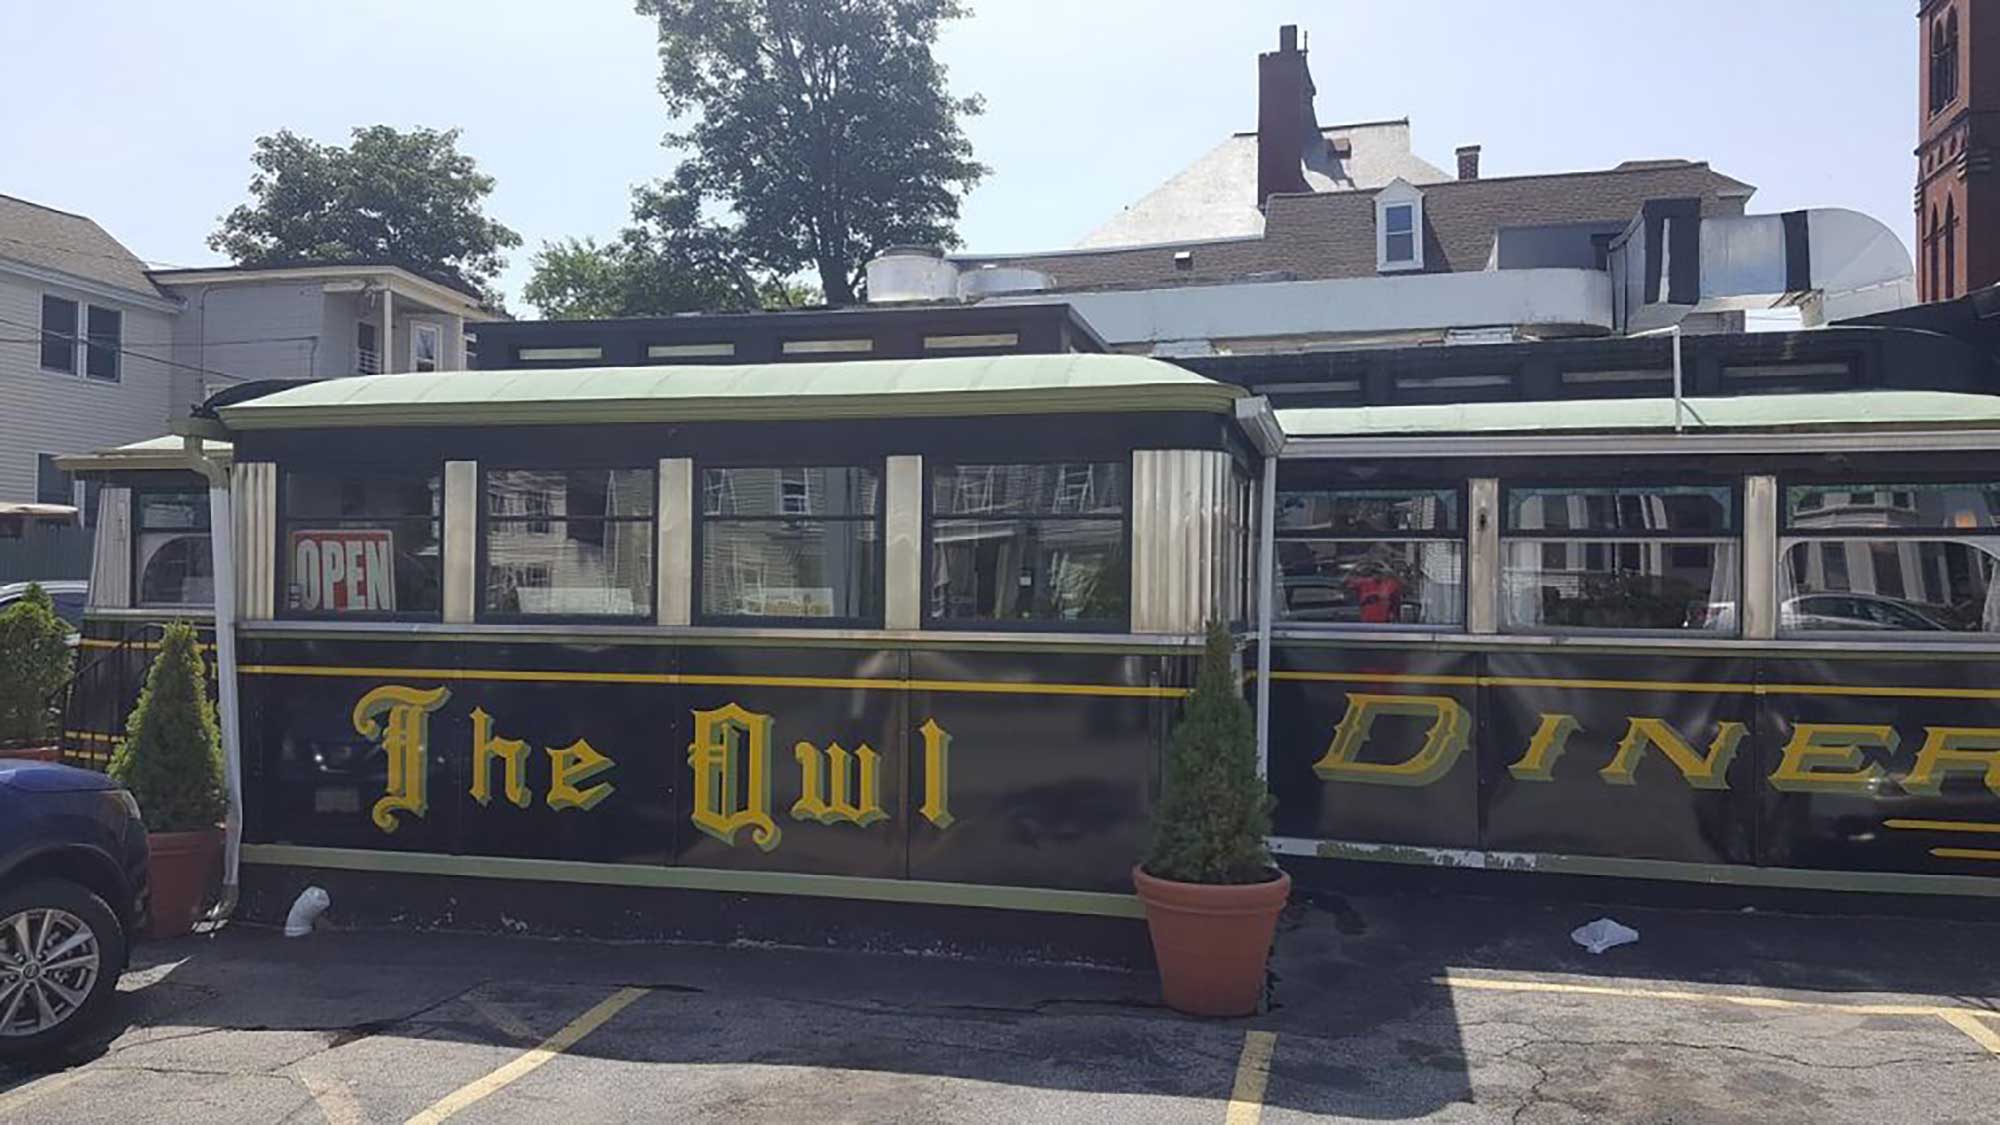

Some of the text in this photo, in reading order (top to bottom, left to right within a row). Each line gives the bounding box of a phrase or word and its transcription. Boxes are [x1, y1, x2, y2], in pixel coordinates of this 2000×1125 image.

[296, 539, 391, 611] OPEN
[352, 685, 617, 833] The
[1311, 692, 2000, 797] DINER
